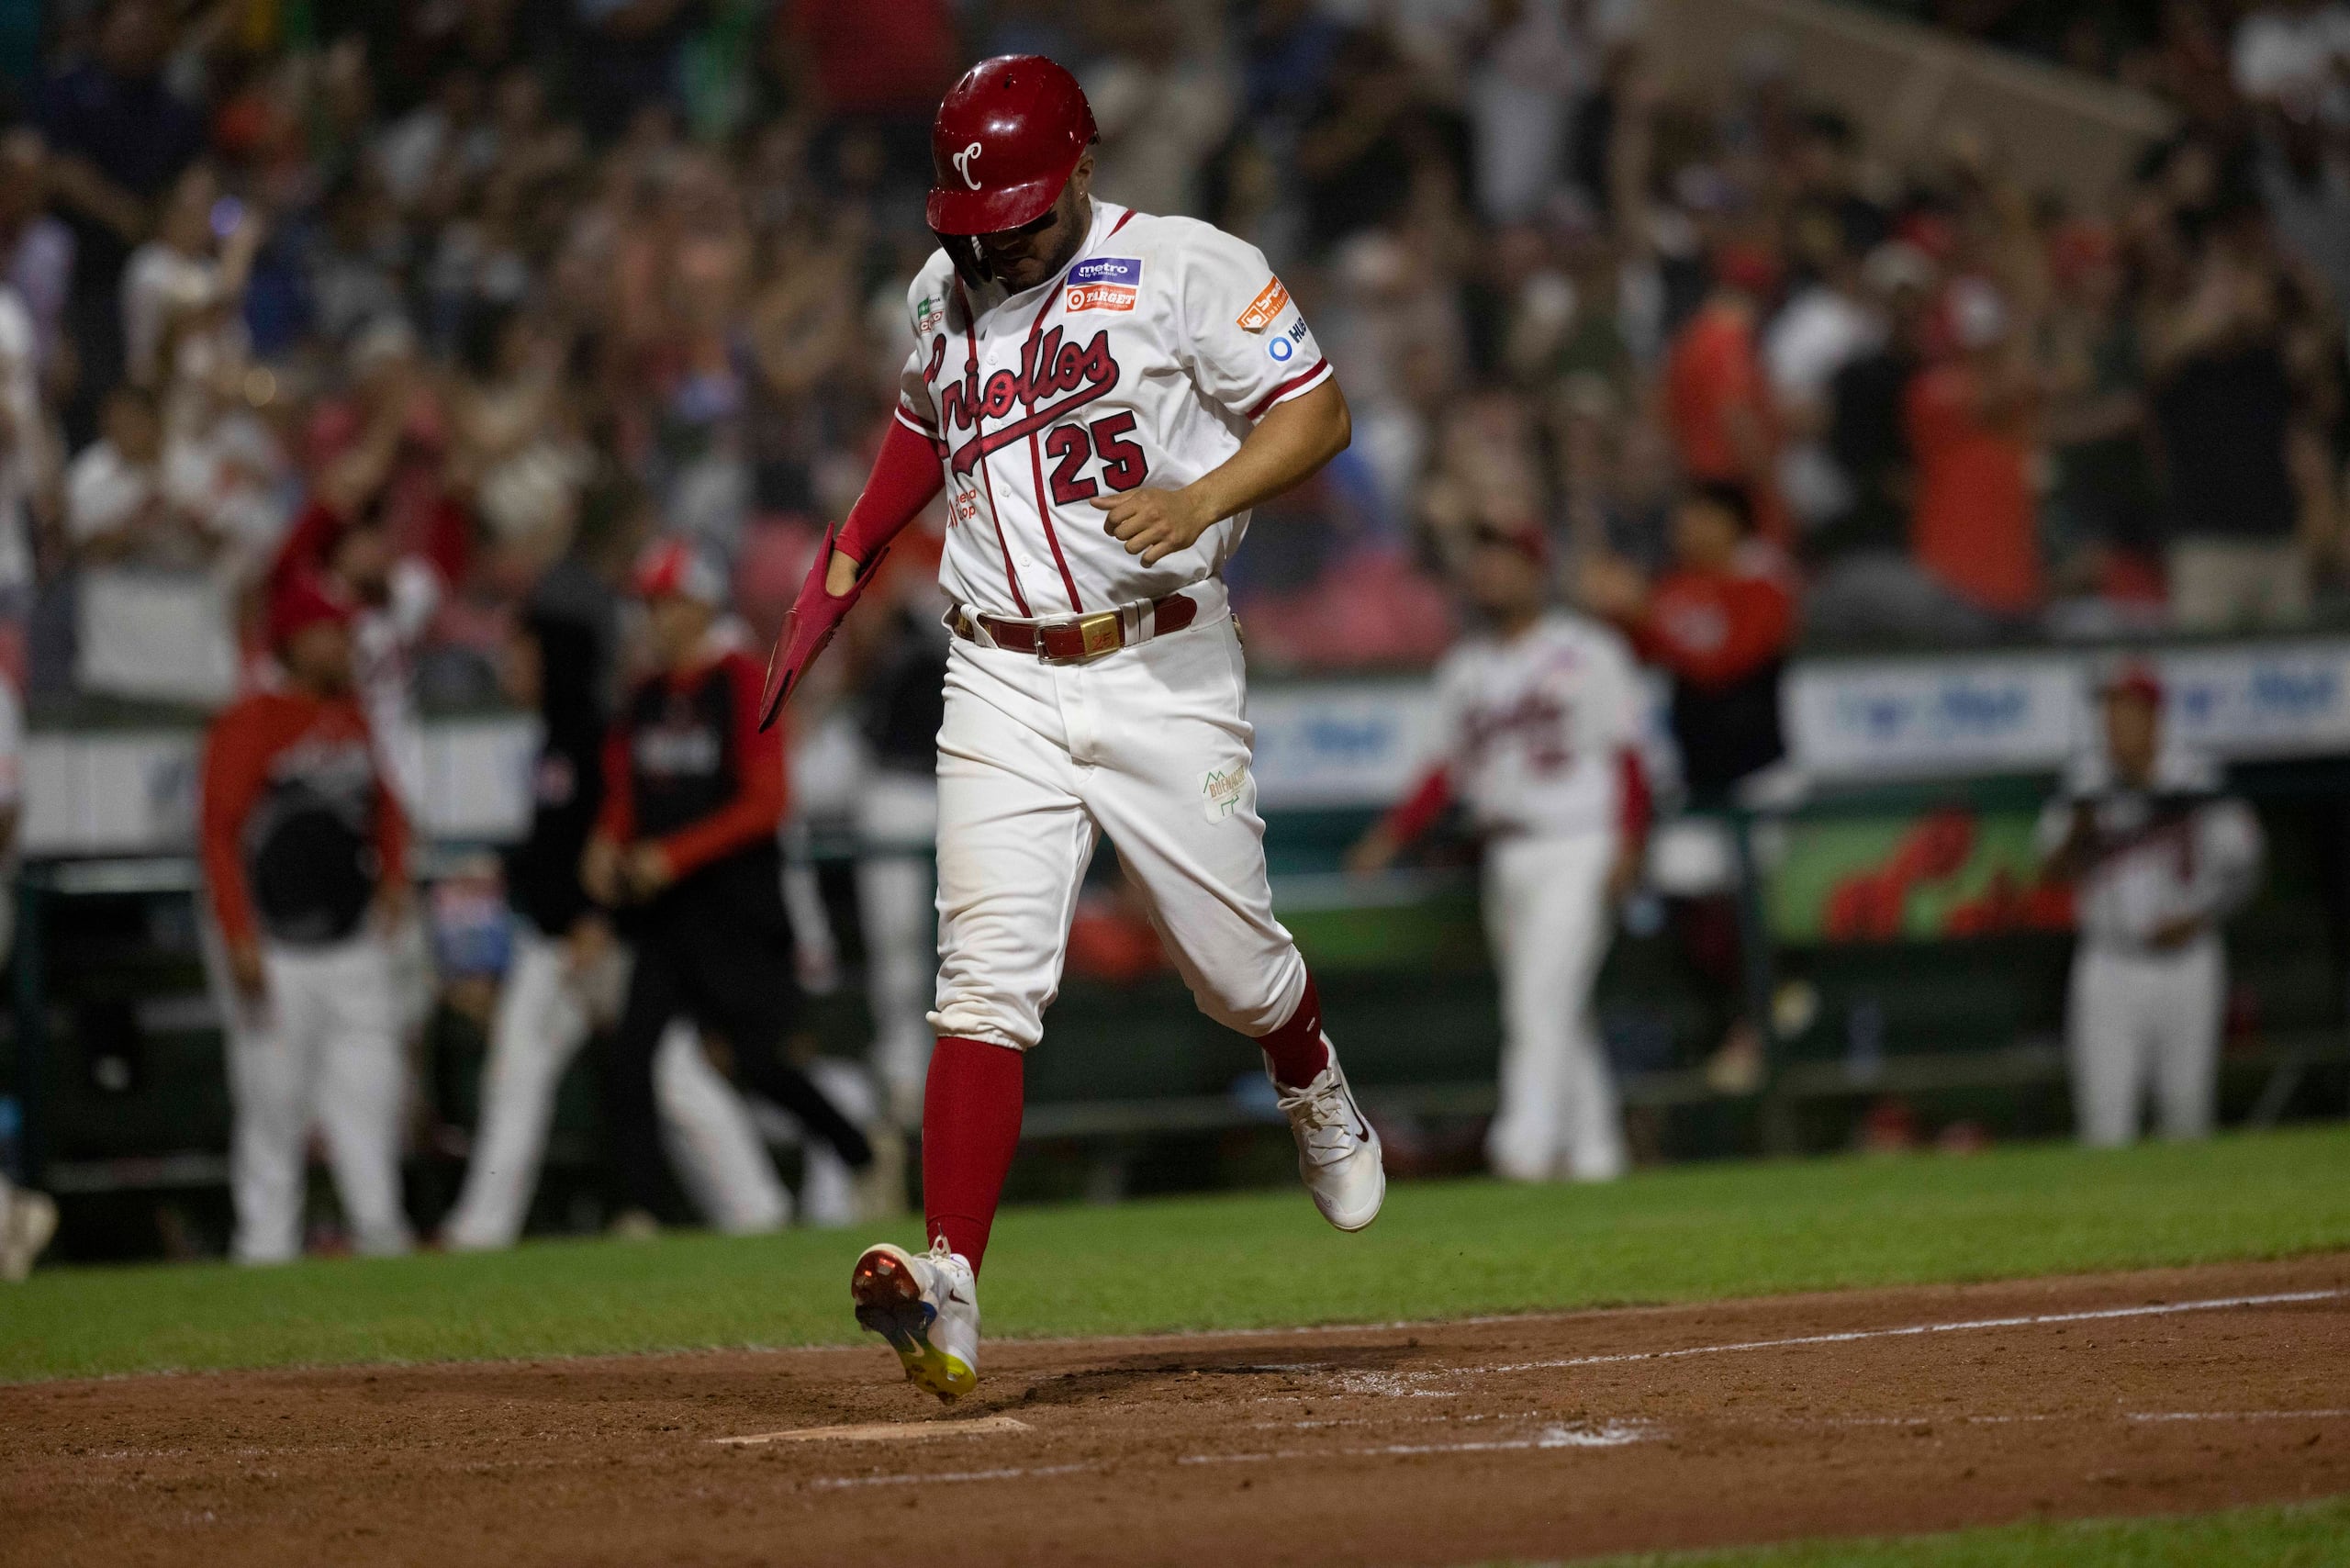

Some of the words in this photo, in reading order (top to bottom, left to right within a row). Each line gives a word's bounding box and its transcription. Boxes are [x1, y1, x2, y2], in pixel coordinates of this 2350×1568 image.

[1079, 263, 1128, 277] metro
[1086, 291, 1135, 305] TARGET
[1046, 410, 1148, 507] 25
[1091, 632, 1114, 650] 25
